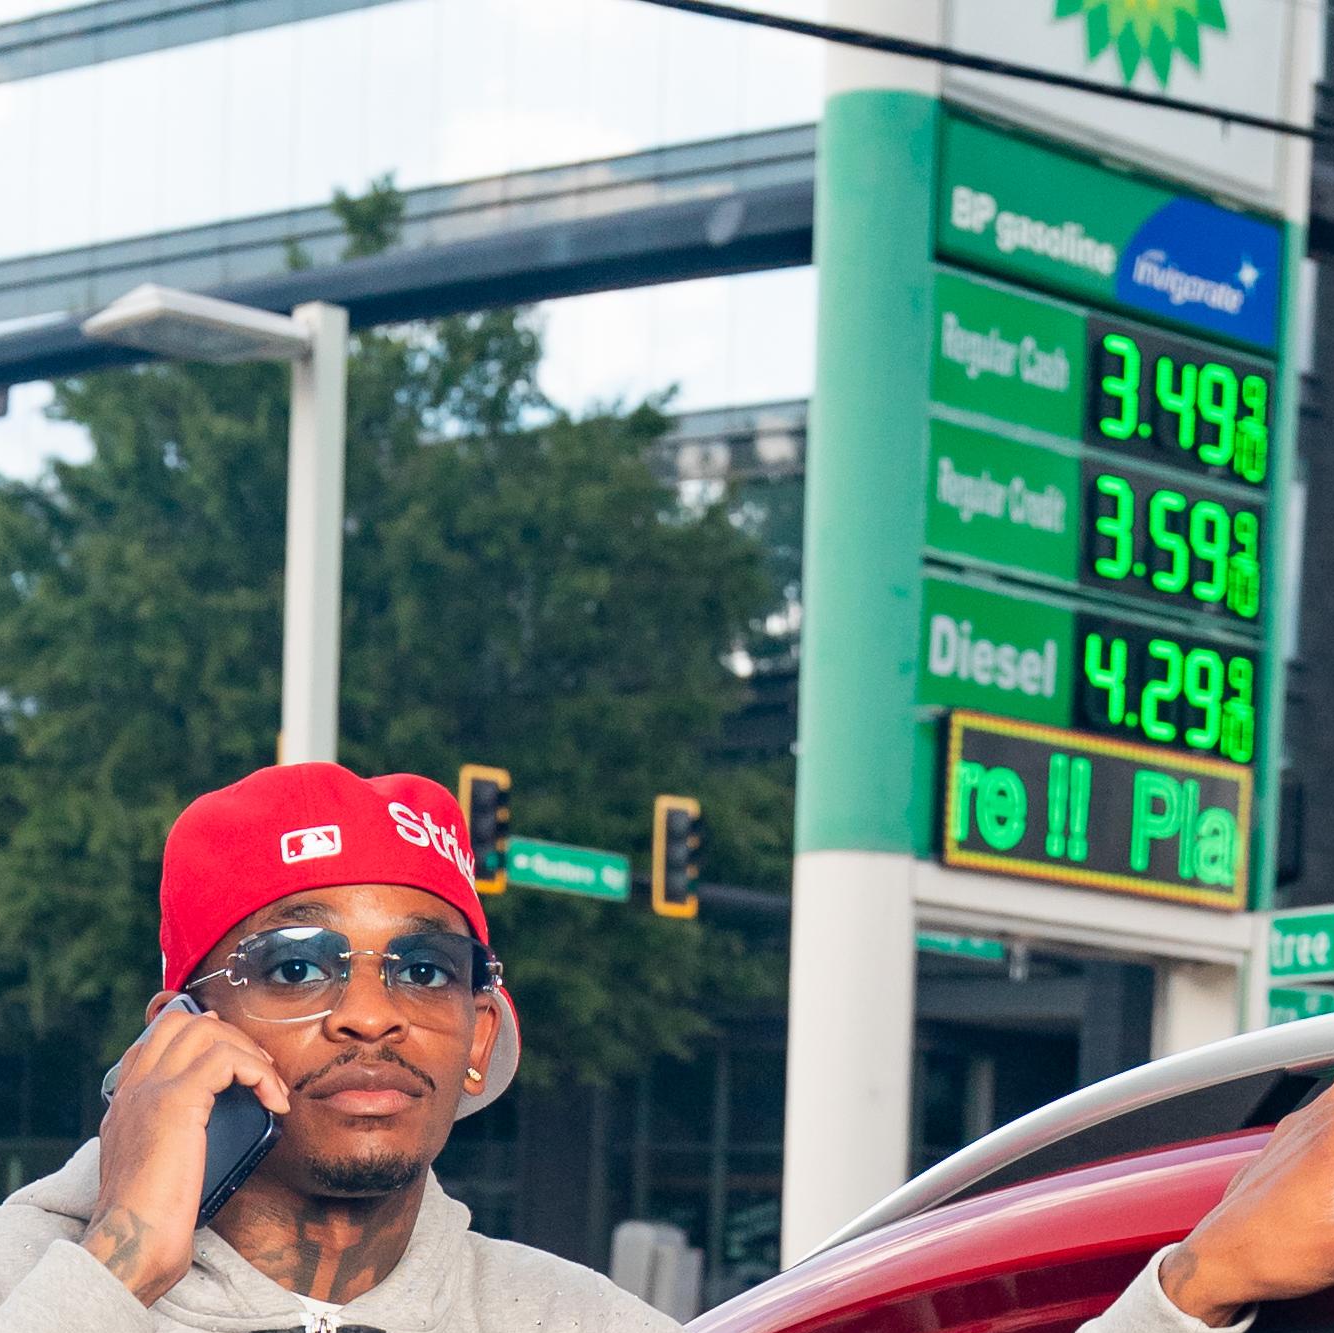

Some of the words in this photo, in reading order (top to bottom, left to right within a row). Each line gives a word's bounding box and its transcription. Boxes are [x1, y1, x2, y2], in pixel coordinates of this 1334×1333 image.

[952, 186, 998, 234] BP
[995, 211, 1117, 276] gasoline
[941, 311, 1018, 379] Regular
[1019, 336, 1070, 392] Cash
[936, 456, 1007, 522] Regular
[1008, 476, 1066, 533] Credit
[929, 614, 1058, 698] Diesel
